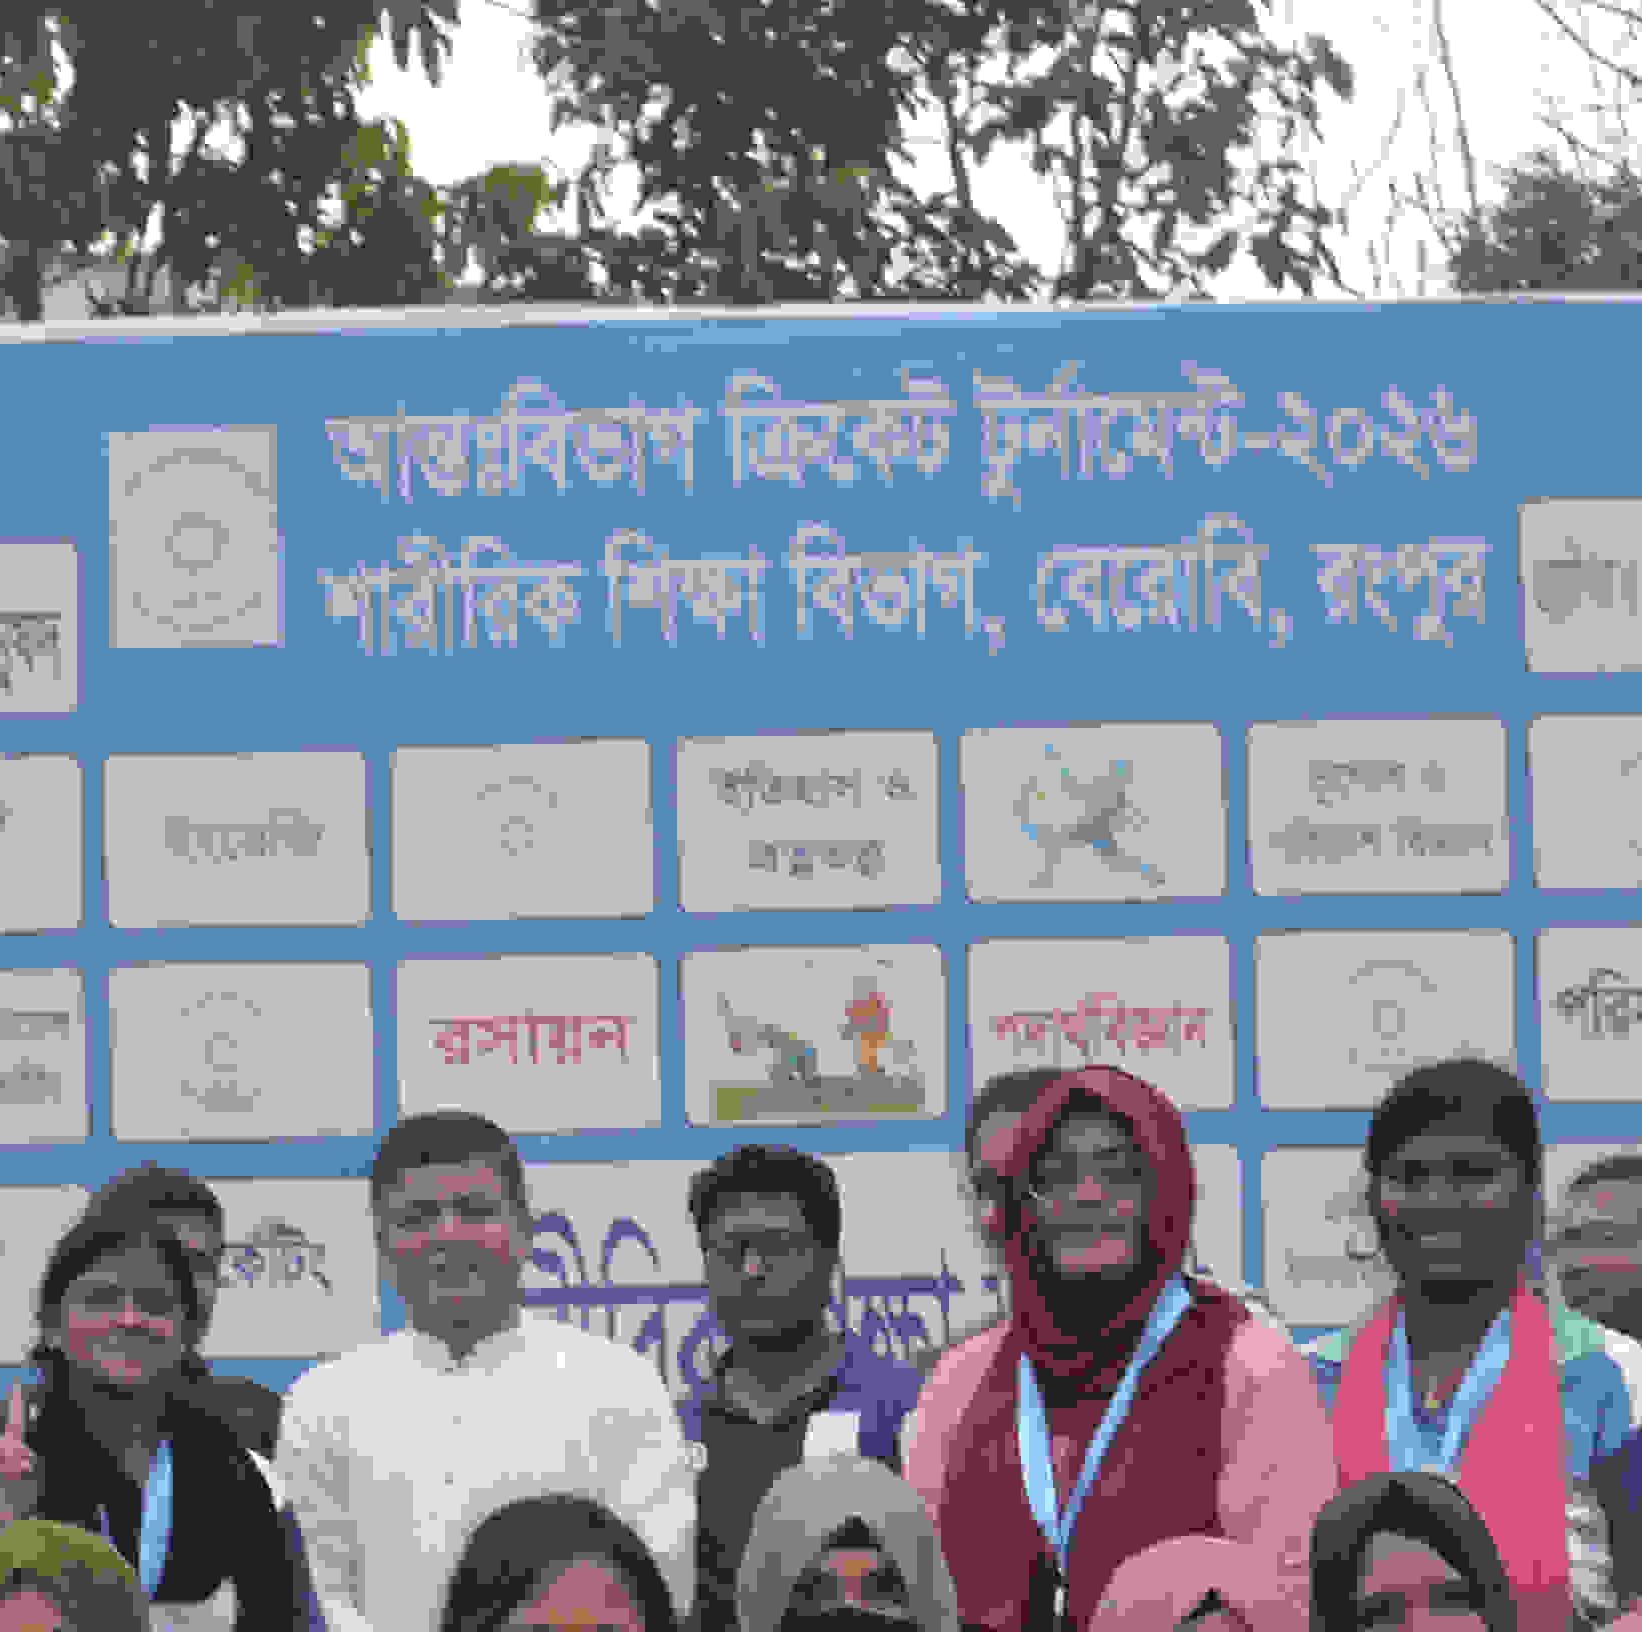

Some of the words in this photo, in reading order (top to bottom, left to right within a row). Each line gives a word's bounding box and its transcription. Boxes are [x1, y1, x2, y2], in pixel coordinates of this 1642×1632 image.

[717, 358, 957, 484] ক্রিকেট
[317, 533, 583, 656] শারীরিক
[597, 527, 773, 646] শিক্ষা
[787, 520, 1007, 656] বিভাগ,
[1307, 535, 1493, 648] রংপুর
[431, 1008, 641, 1068] রসায়ন
